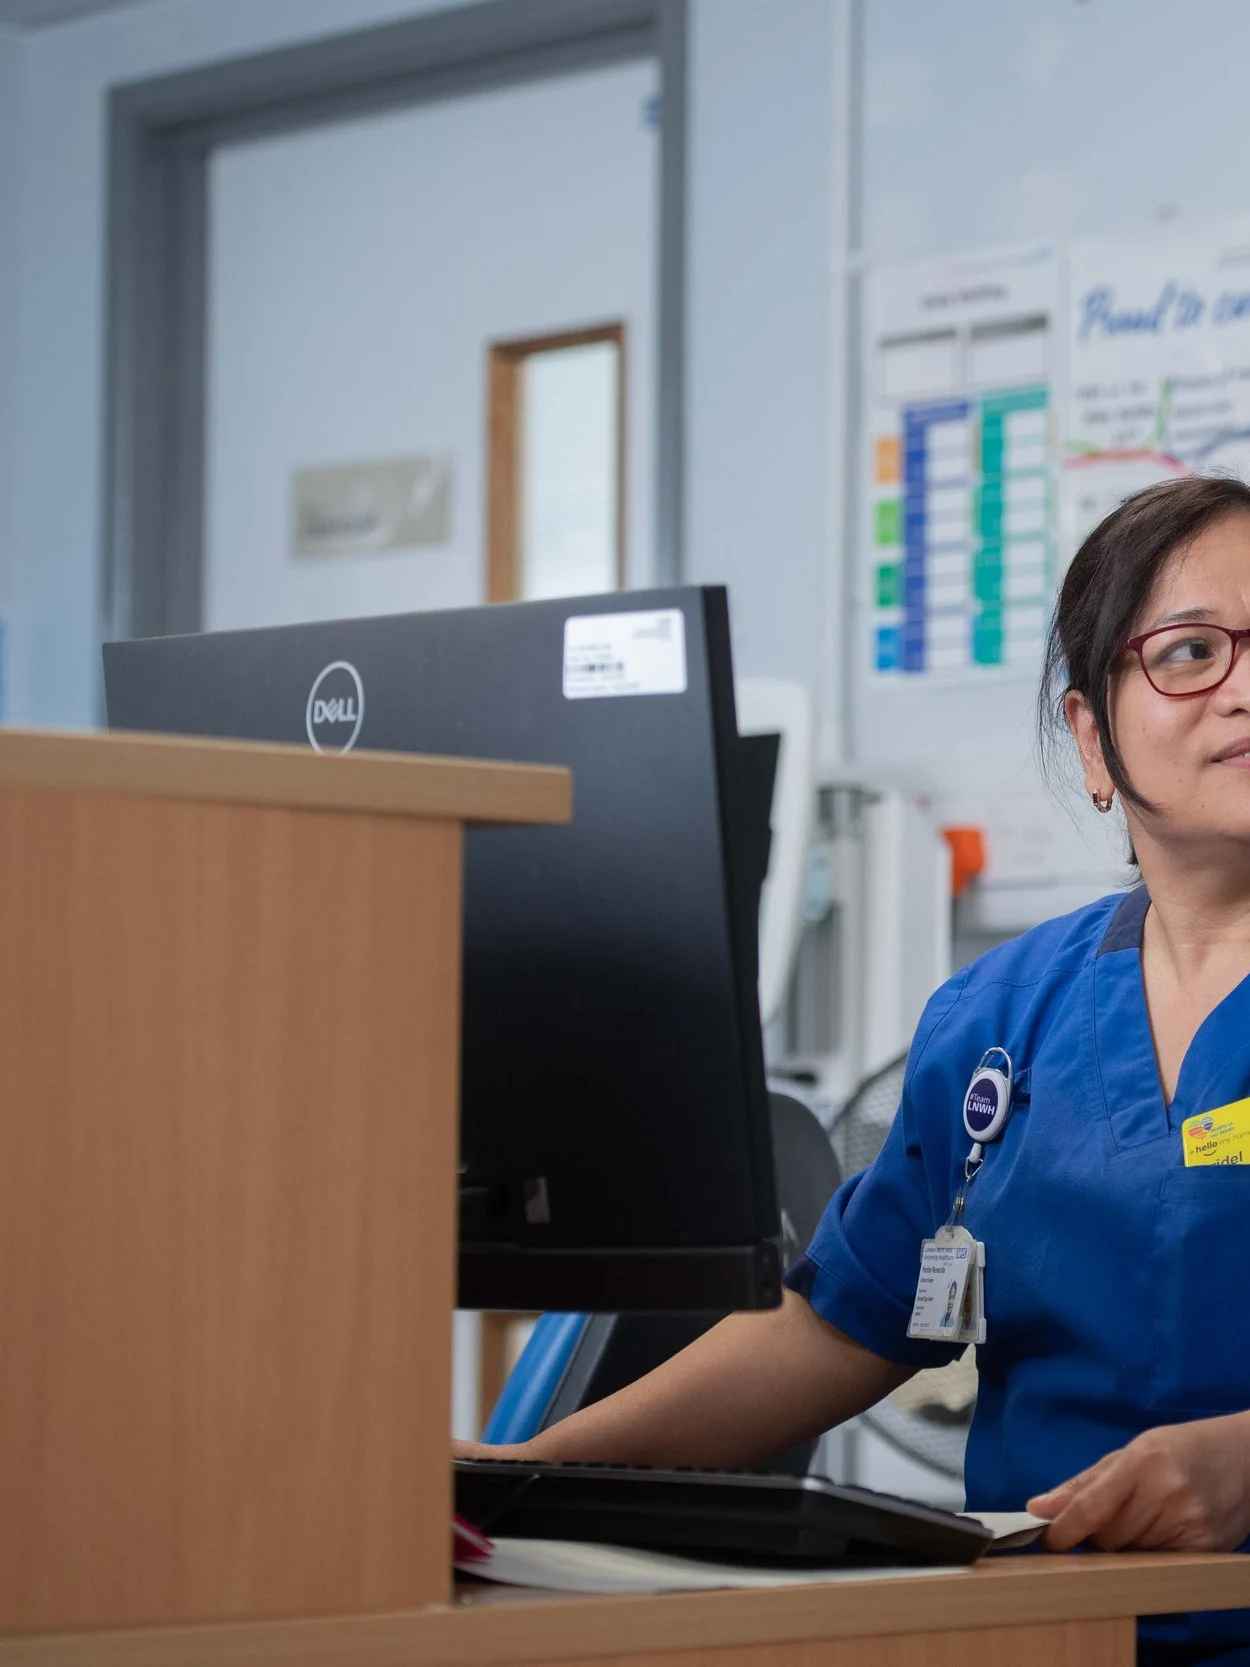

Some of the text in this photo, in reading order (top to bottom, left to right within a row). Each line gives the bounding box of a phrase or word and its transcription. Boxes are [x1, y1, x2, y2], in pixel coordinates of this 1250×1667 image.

[313, 696, 357, 724] DELL
[970, 1093, 991, 1105] #Team
[967, 1100, 996, 1116] LNWH
